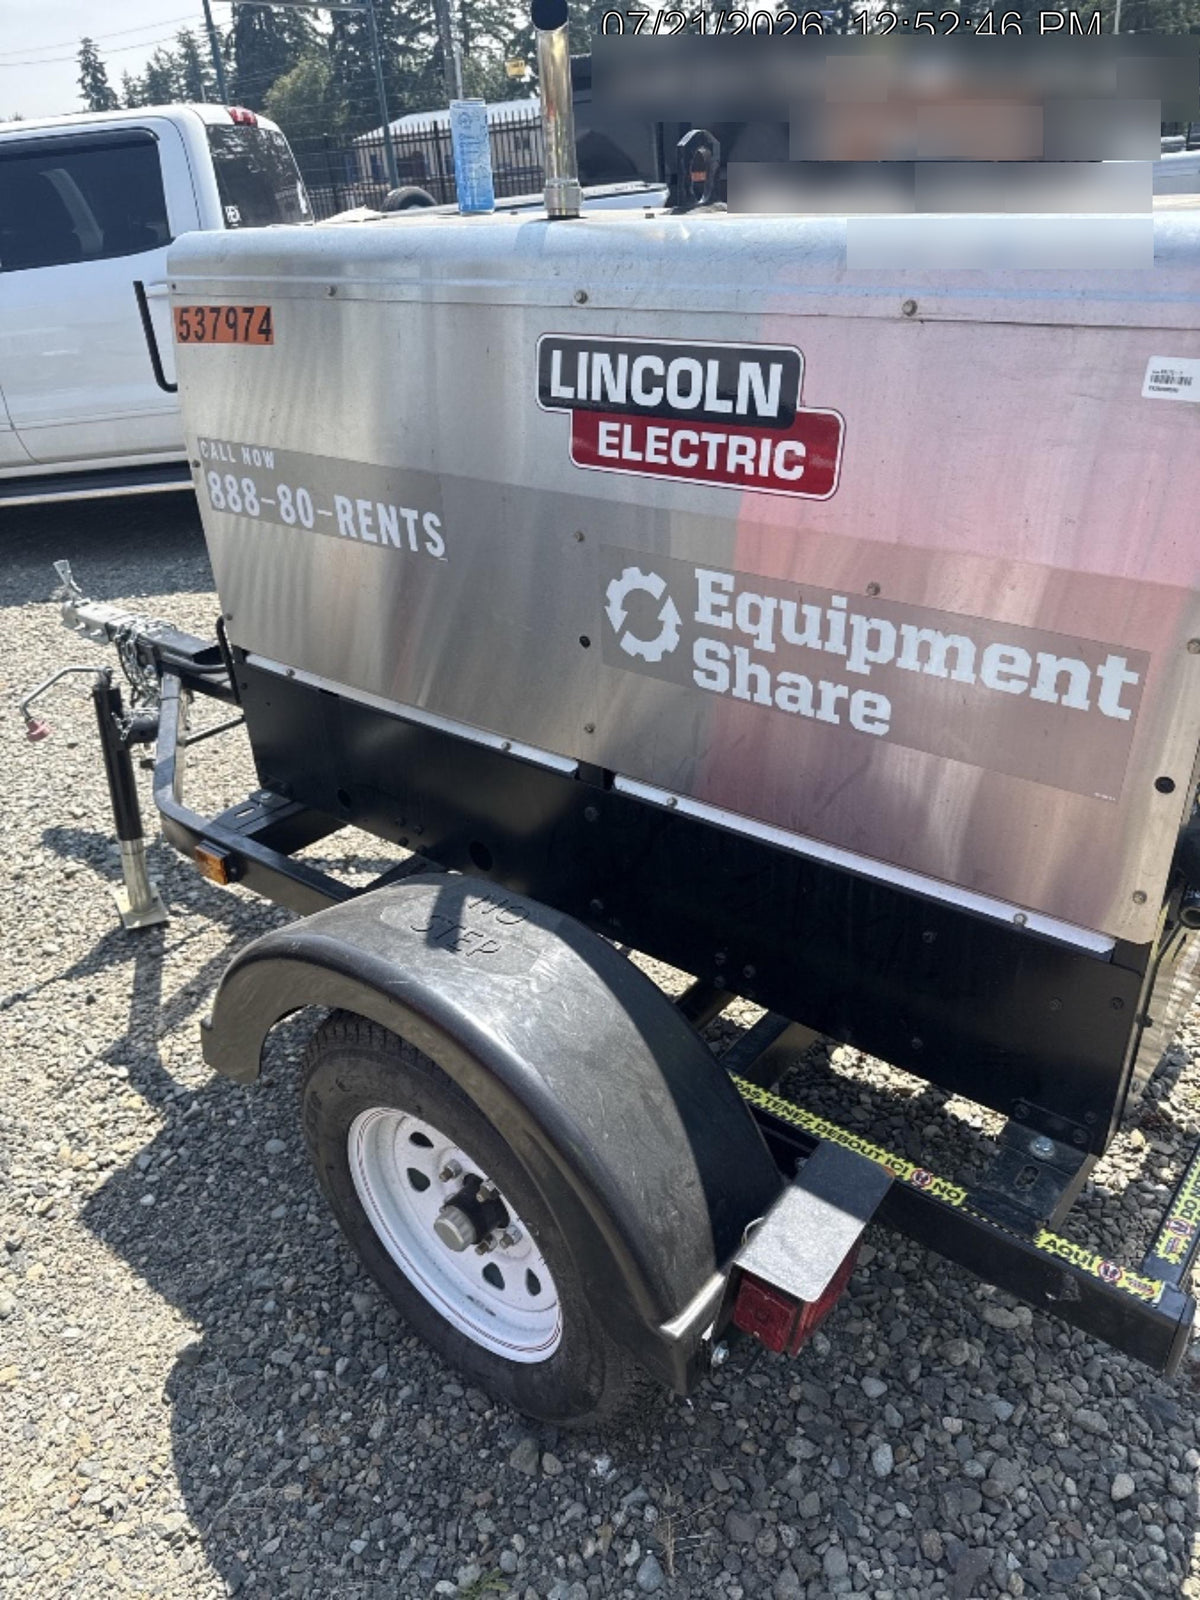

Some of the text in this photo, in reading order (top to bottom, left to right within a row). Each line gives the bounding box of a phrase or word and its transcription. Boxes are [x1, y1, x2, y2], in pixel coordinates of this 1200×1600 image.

[178, 306, 273, 343] 537974
[550, 349, 783, 418] LINCOLN
[200, 440, 275, 470] CALL NOW
[598, 421, 806, 482] ELECTRIC
[207, 471, 446, 559] 888-80-RENTS
[695, 567, 1139, 721] Equipment
[692, 637, 892, 736] Share
[410, 914, 502, 957] STEP
[468, 894, 530, 925] NO
[766, 1096, 813, 1125] TENEZ
[814, 1121, 885, 1163] DEBOUT
[885, 1157, 910, 1175] ICI
[933, 1181, 962, 1201] NO
[1179, 1199, 1198, 1219] DO
